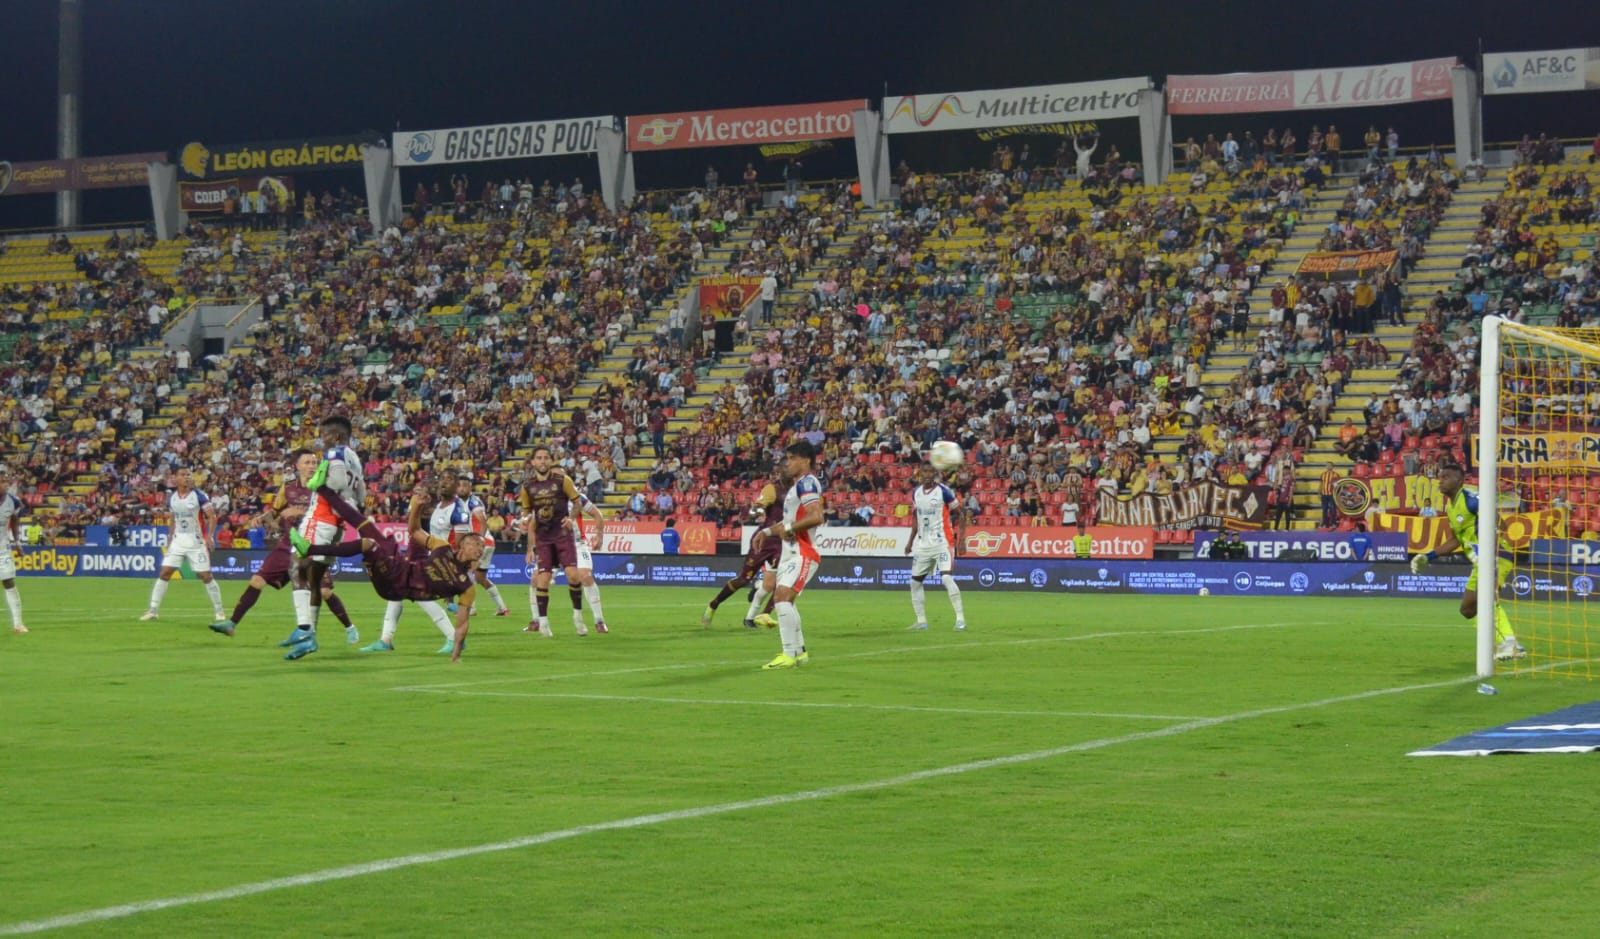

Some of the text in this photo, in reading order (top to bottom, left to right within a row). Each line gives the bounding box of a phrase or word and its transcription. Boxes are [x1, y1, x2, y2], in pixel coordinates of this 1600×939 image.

[1523, 56, 1577, 75] AF&C
[1169, 85, 1291, 104] FERRETERÍA
[1303, 69, 1406, 104] Al día
[976, 90, 1139, 118] Multicentro
[688, 112, 850, 142] Mercacentro
[444, 123, 546, 161] GASEOSAS
[213, 143, 368, 172] LEÓN GRÁFICAS
[1581, 437, 1600, 462] P
[1370, 478, 1400, 510] EL
[607, 535, 633, 552] día
[816, 532, 897, 553] ComfaTolima
[1008, 532, 1145, 555] Mercaentro
[82, 554, 155, 572] DIMAYOR
[594, 572, 615, 580] Vigilado
[616, 573, 645, 581] Supersalud
[818, 575, 842, 584] Vigilado
[842, 576, 874, 584] Supersalud
[1060, 578, 1120, 587] Vigilado Supersalud
[1323, 582, 1350, 592] Vigilado
[1351, 583, 1388, 592] Supersalud
